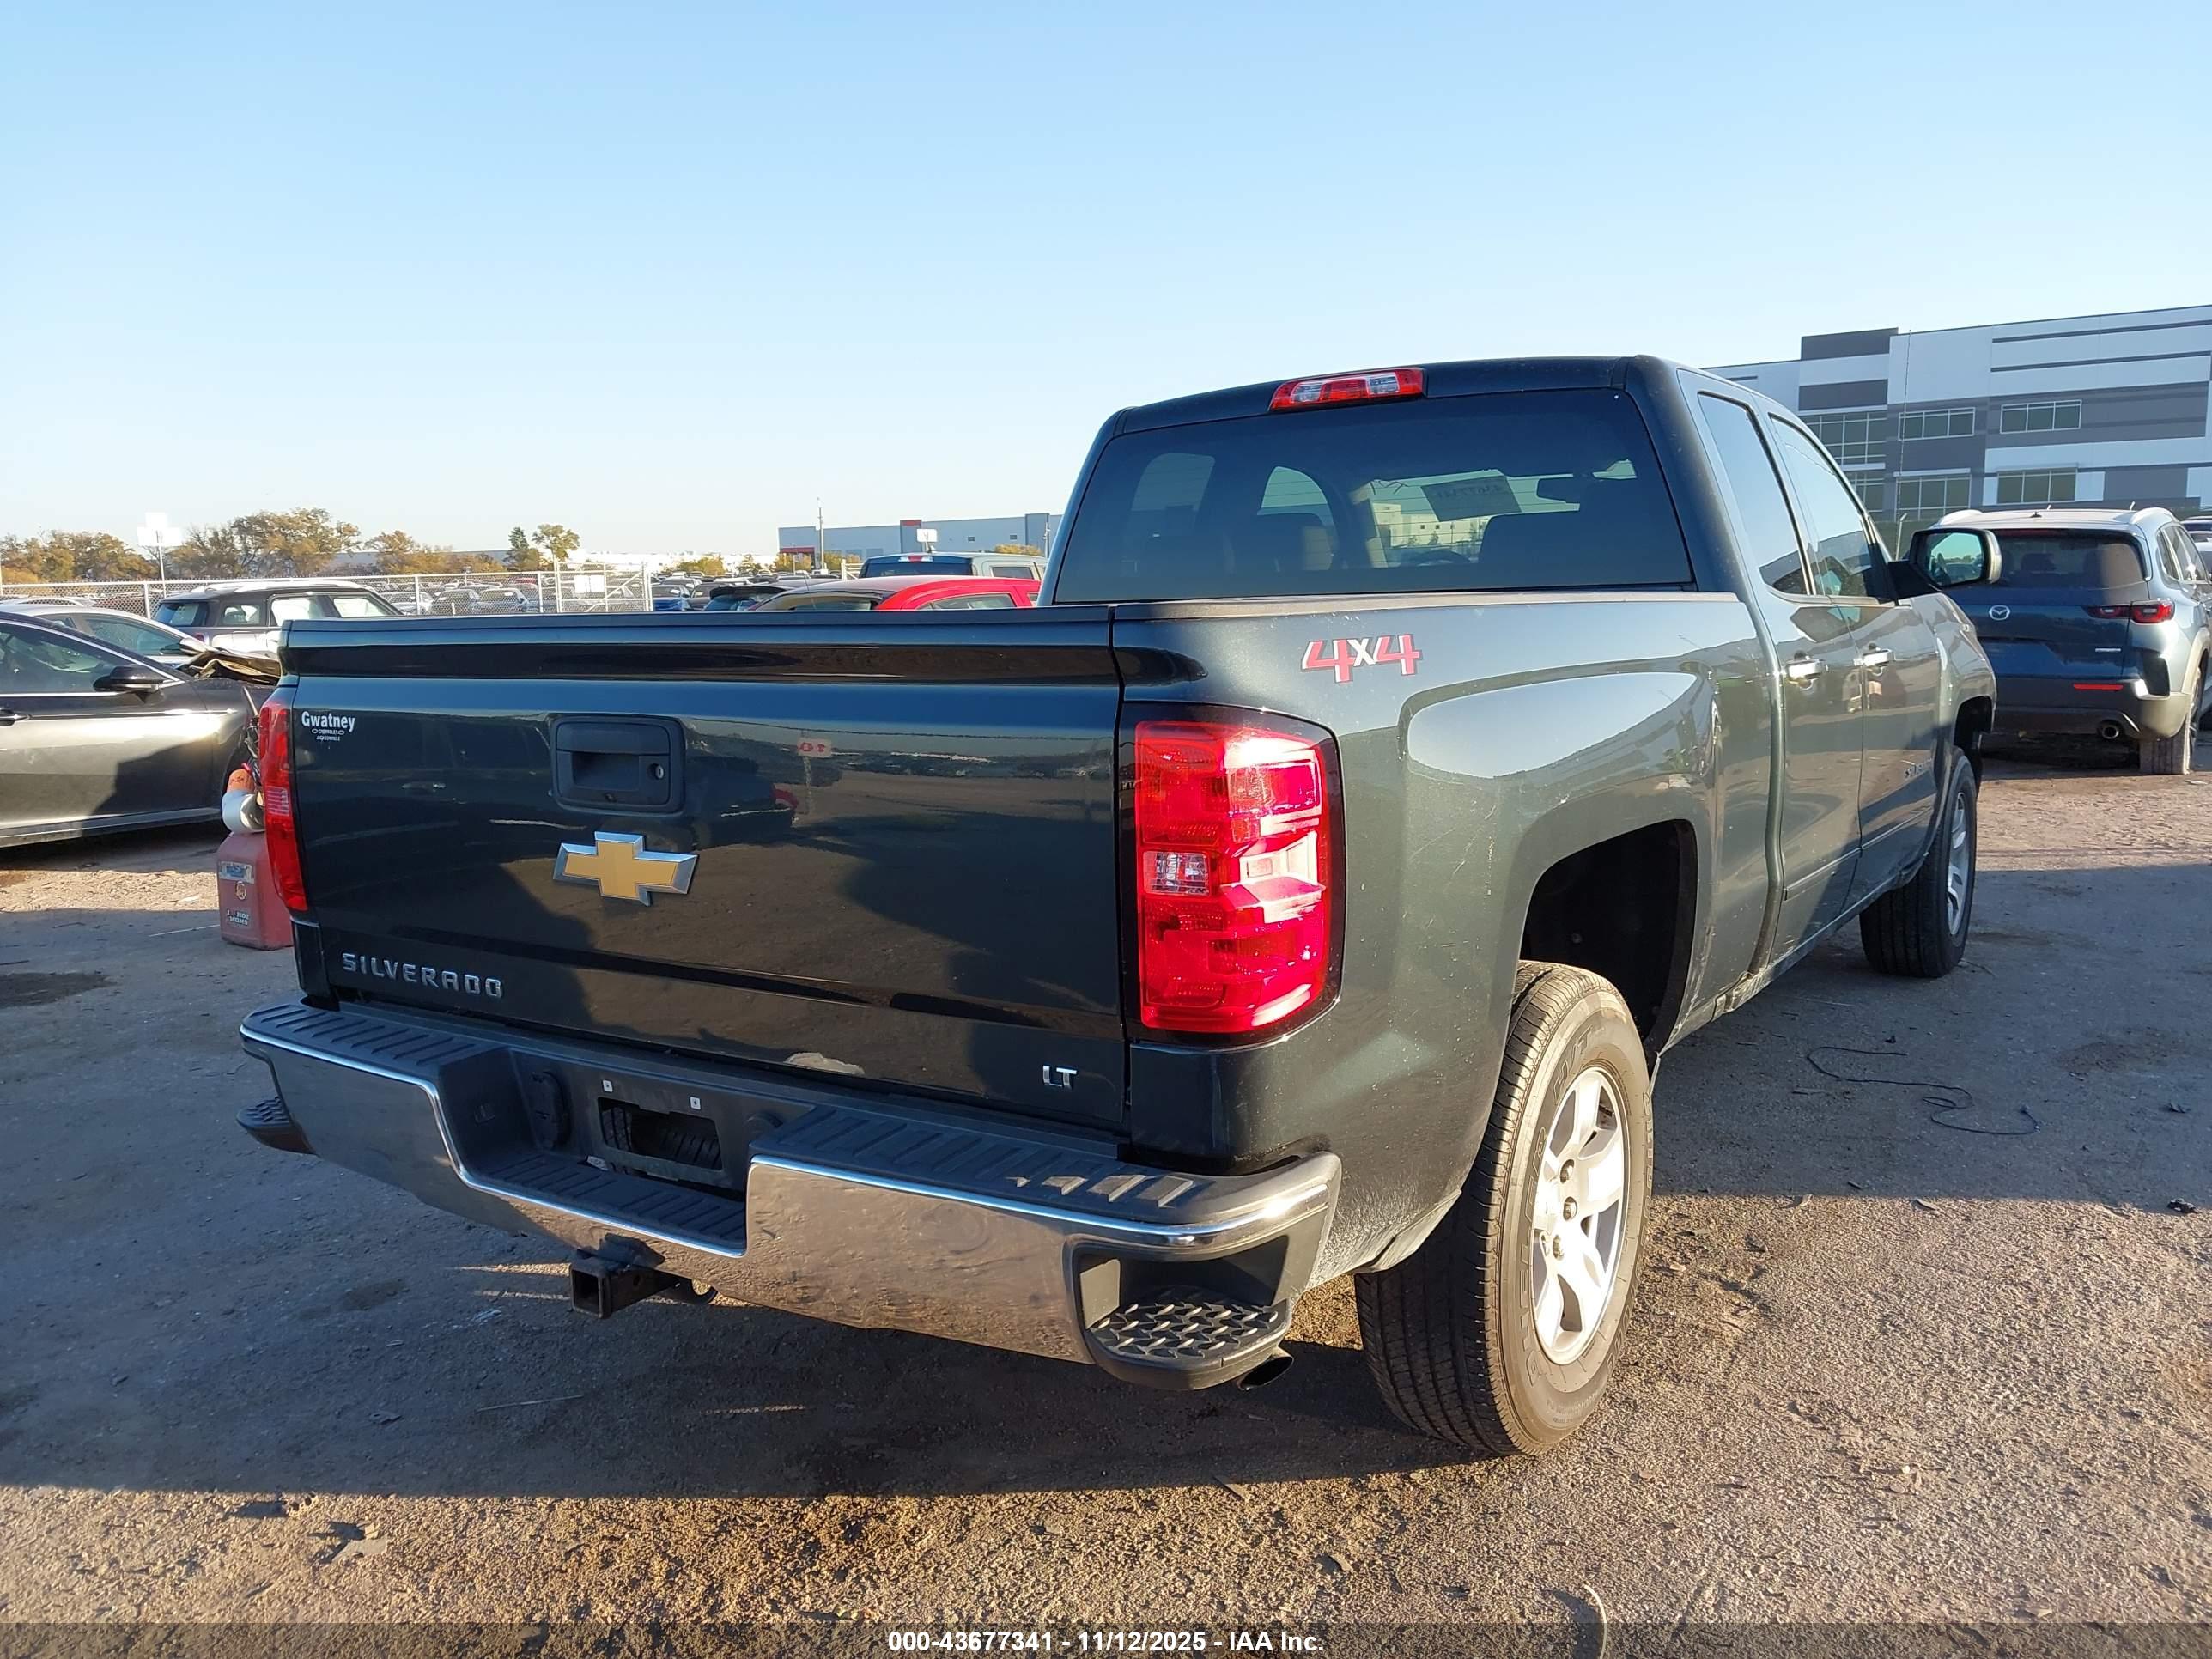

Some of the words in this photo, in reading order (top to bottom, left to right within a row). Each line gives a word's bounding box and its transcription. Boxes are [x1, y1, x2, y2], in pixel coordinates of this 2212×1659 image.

[301, 711, 356, 732] Gwatney
[342, 952, 502, 998] SILVERADO
[1042, 1065, 1078, 1087] LT
